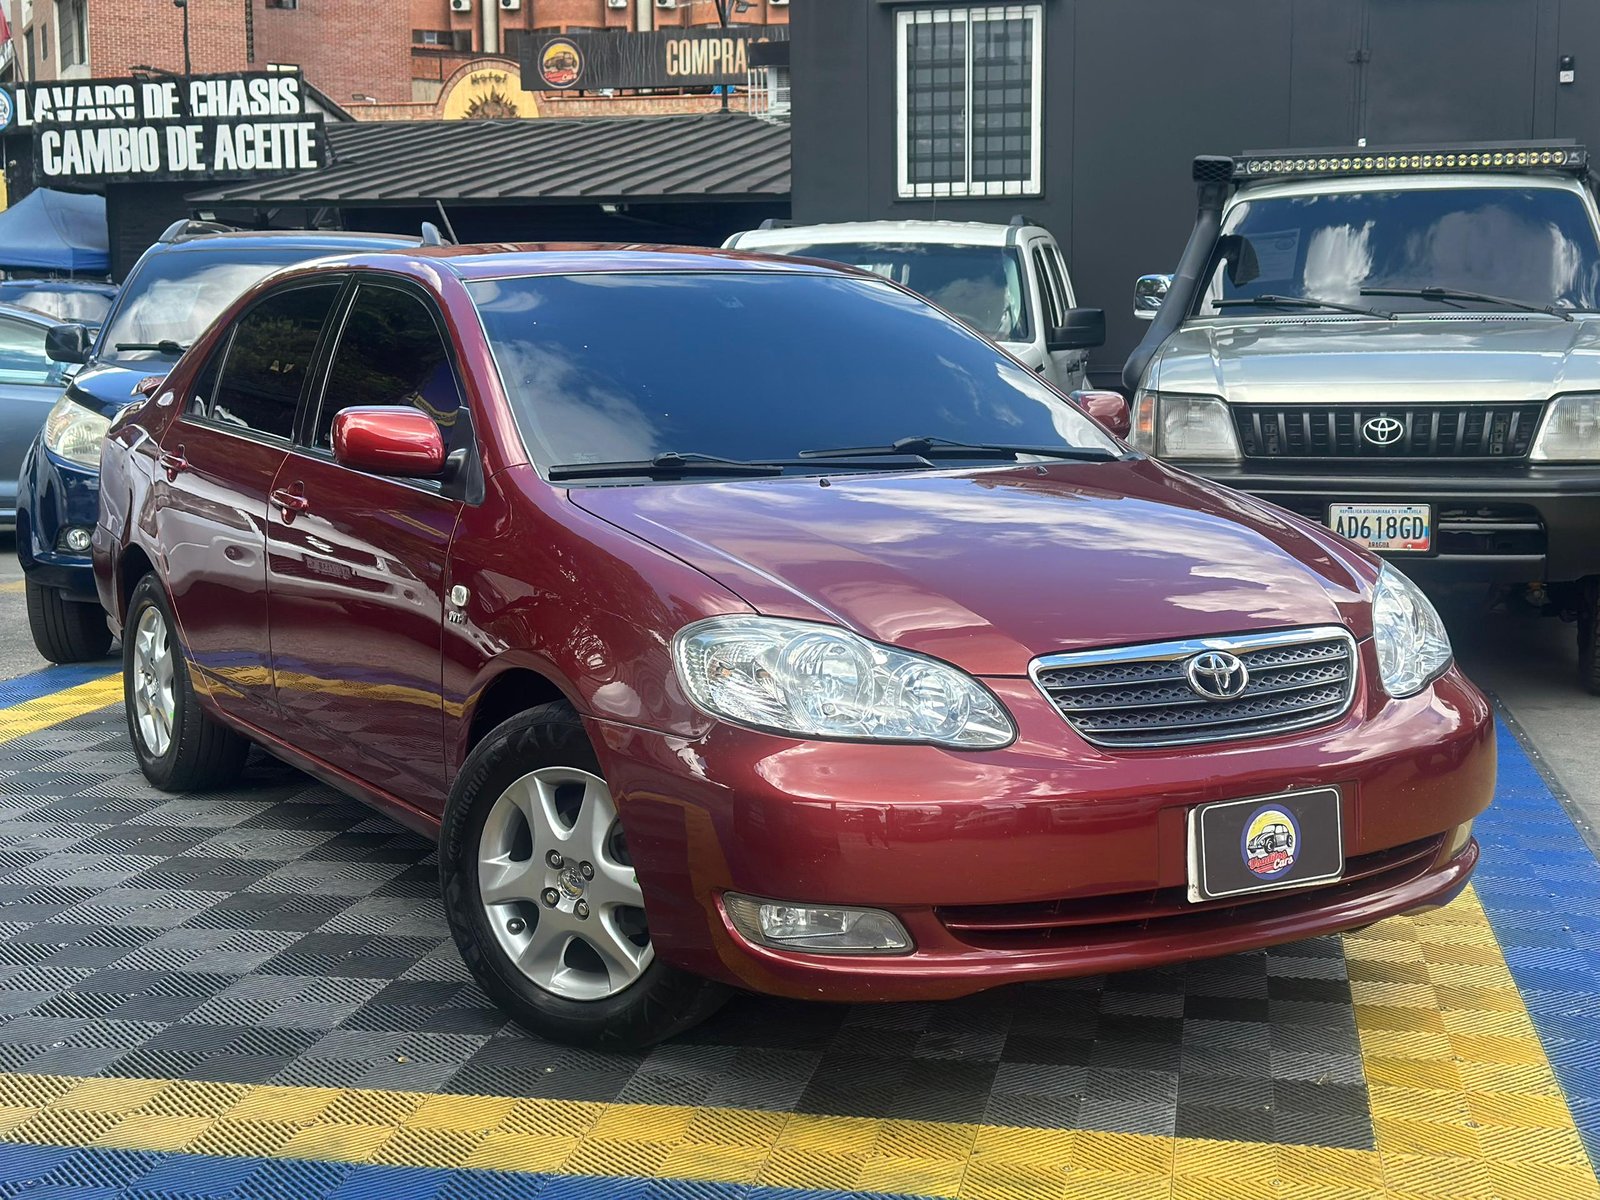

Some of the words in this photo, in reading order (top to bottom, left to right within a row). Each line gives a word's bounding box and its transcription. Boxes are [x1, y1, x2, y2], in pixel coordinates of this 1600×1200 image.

[666, 37, 770, 76] COMPRA
[16, 85, 136, 126] LAVADO
[142, 82, 181, 119] DE
[189, 77, 299, 117] CHASIS
[41, 126, 160, 176] CAMBIO
[166, 124, 206, 172] DE
[213, 121, 318, 171] ACEITE
[1337, 516, 1424, 539] AD618GD
[1273, 855, 1294, 870] Cars
